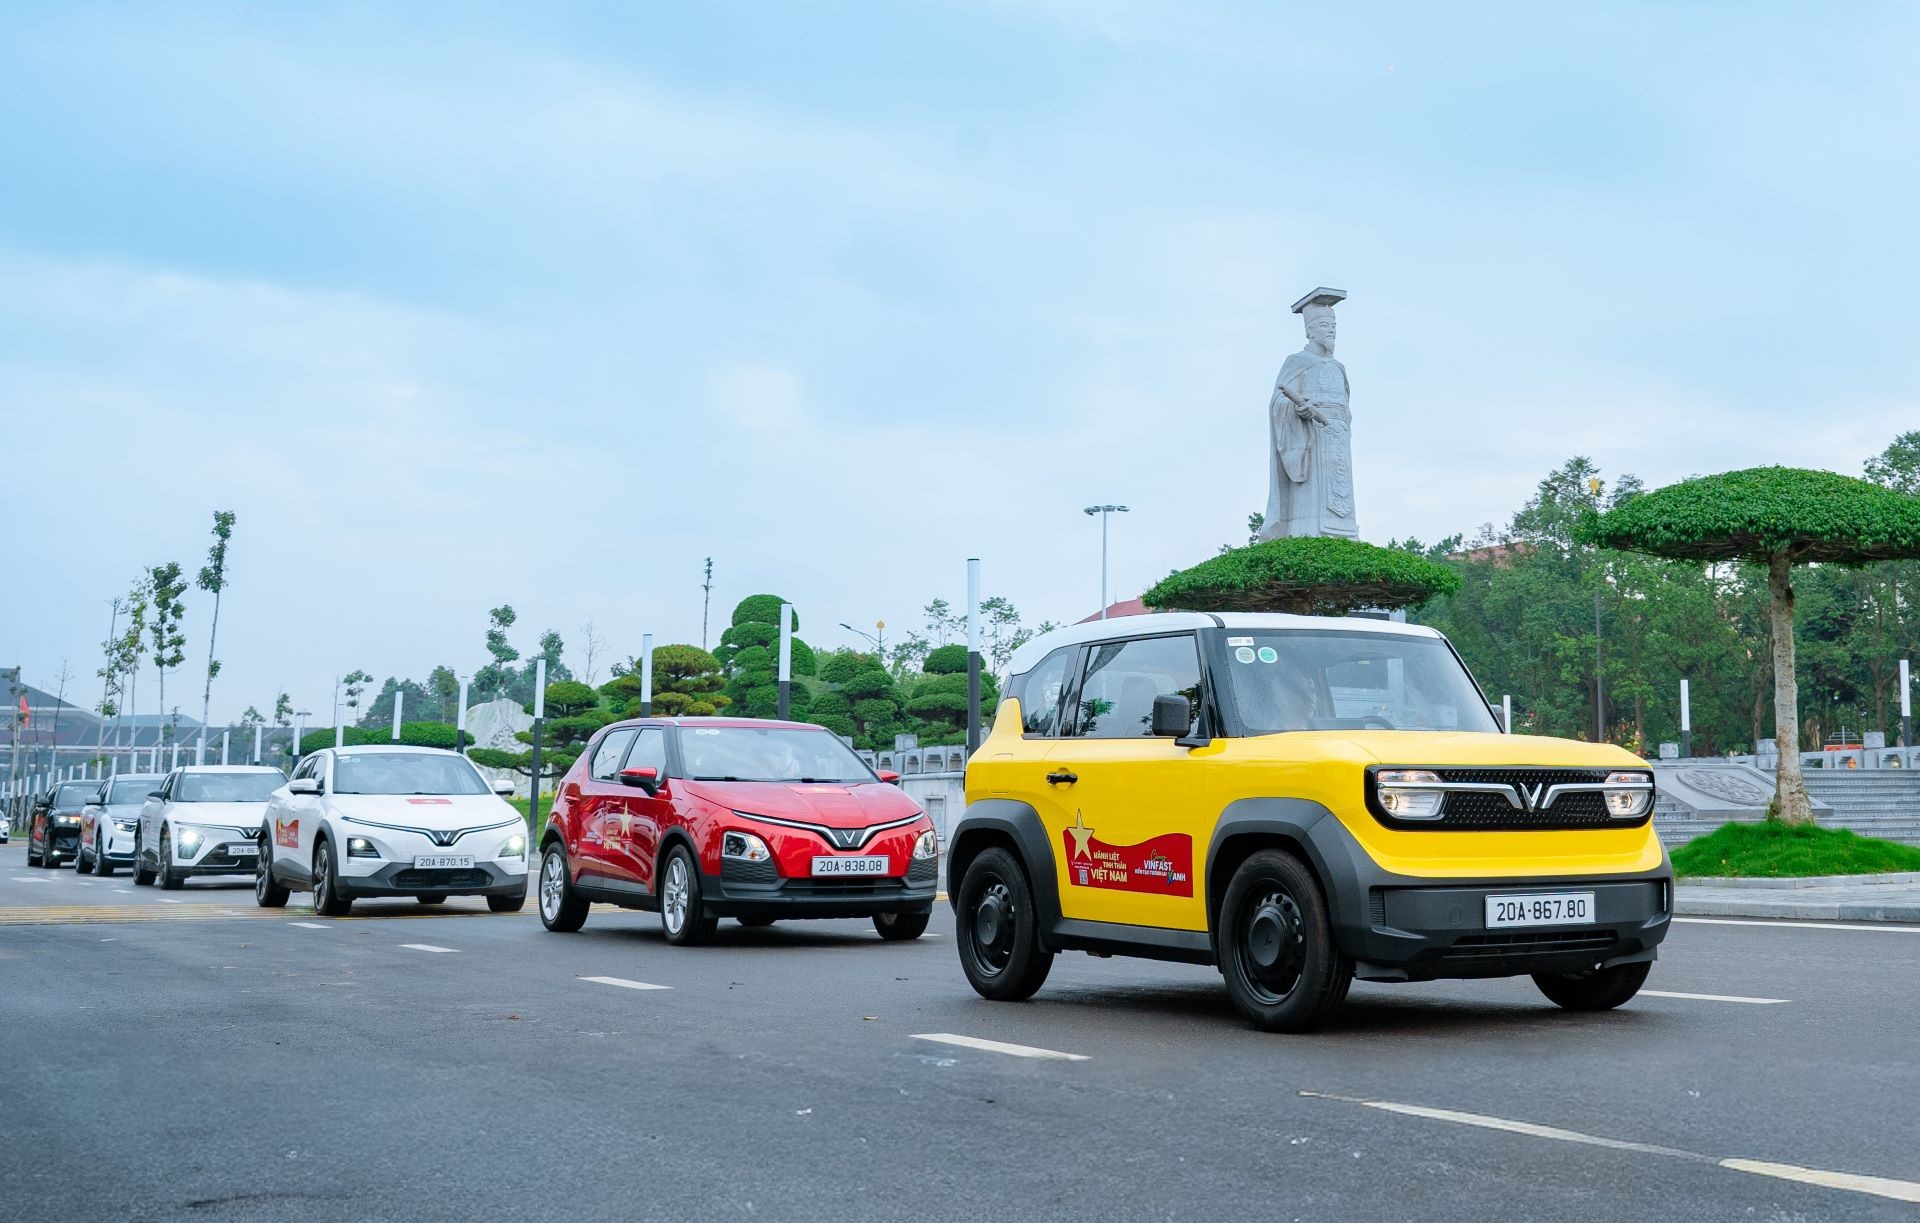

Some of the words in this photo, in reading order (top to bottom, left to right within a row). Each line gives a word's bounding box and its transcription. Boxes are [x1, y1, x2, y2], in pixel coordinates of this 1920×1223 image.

[420, 858, 469, 867] 20A-870.15
[819, 860, 882, 872] 20A-838.08
[1143, 860, 1173, 871] VINFAST
[1090, 866, 1108, 883] VIỆT
[1109, 869, 1128, 883] NAM
[1497, 900, 1586, 922] 20A-867.80
